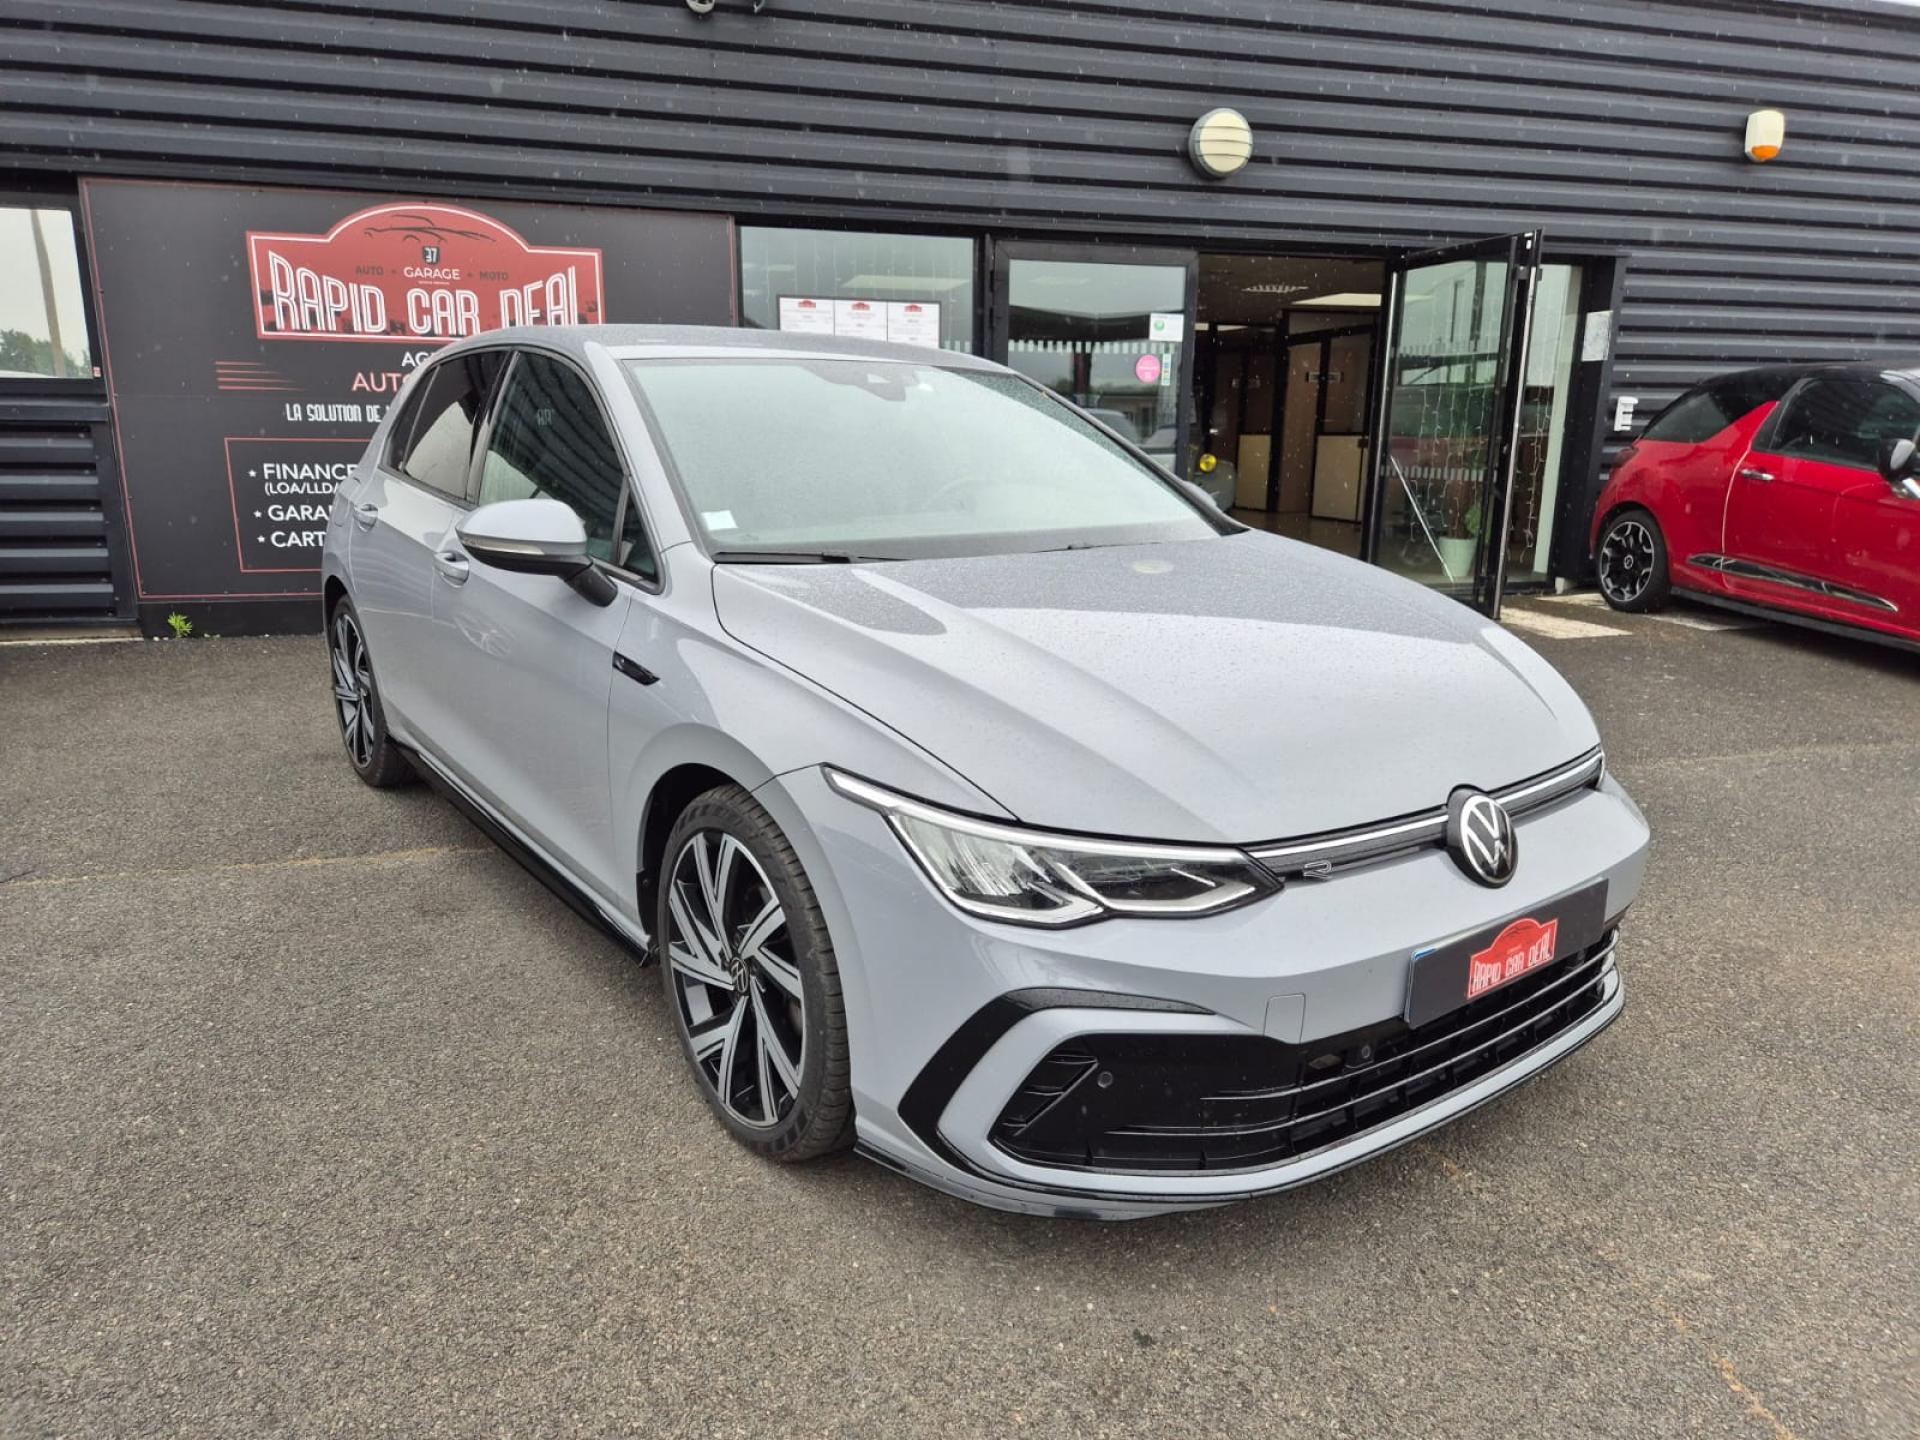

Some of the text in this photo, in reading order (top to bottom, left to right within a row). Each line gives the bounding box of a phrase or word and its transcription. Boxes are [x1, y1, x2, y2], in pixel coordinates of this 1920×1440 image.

[355, 265, 509, 282] AUTO GARAGE MOTO
[268, 250, 579, 336] RAPID CAR DEAL
[286, 403, 382, 423] LA SOLUTION DE
[1471, 959, 1502, 995] RAPID
[1505, 951, 1525, 978] CAR
